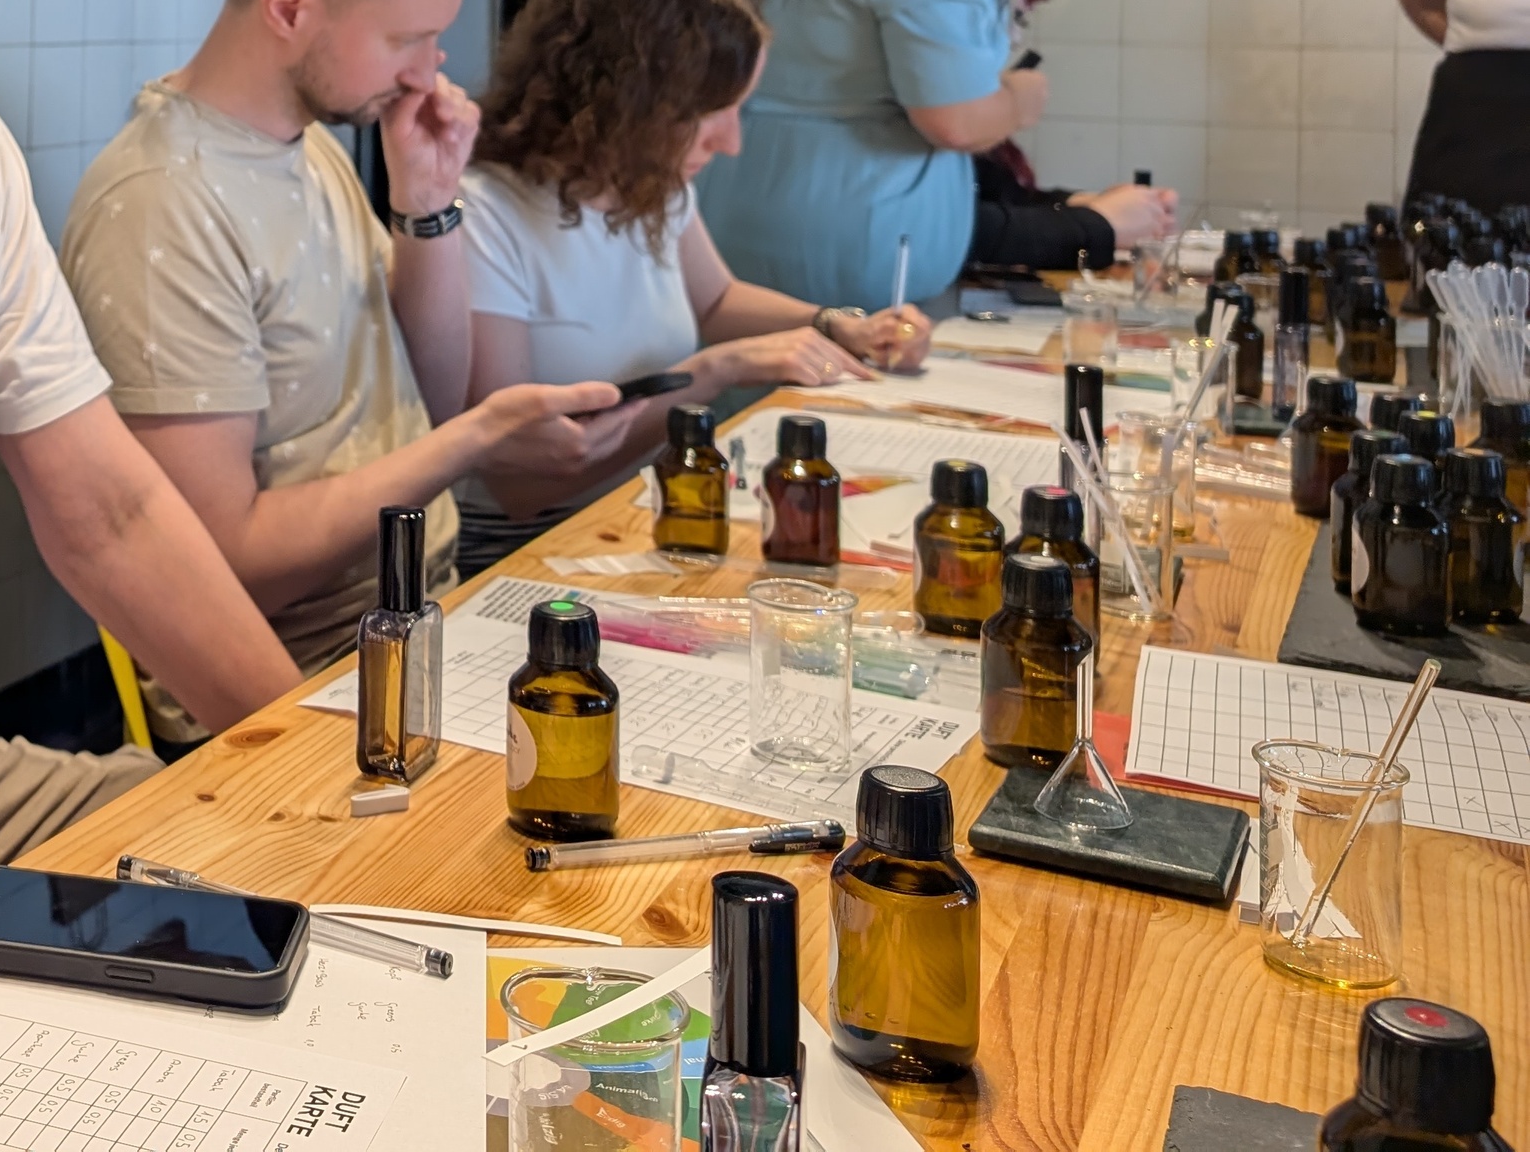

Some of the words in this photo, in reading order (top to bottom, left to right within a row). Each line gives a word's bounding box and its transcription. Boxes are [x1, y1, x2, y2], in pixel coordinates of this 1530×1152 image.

[67, 1039, 95, 1064] Gurke
[108, 1048, 138, 1072] Greens
[14, 1067, 33, 1079] 0,5
[156, 1058, 182, 1083] Ambra
[56, 1078, 76, 1092] 0,5
[104, 1090, 122, 1105] 0,5
[38, 1099, 59, 1114] 0,5
[150, 1099, 168, 1114] 1,0
[286, 1084, 337, 1138] KARTE
[324, 1091, 367, 1133] DUFT
[82, 1111, 101, 1125] 0,5
[192, 1110, 215, 1125] 1,5
[175, 1132, 197, 1149] 0,5
